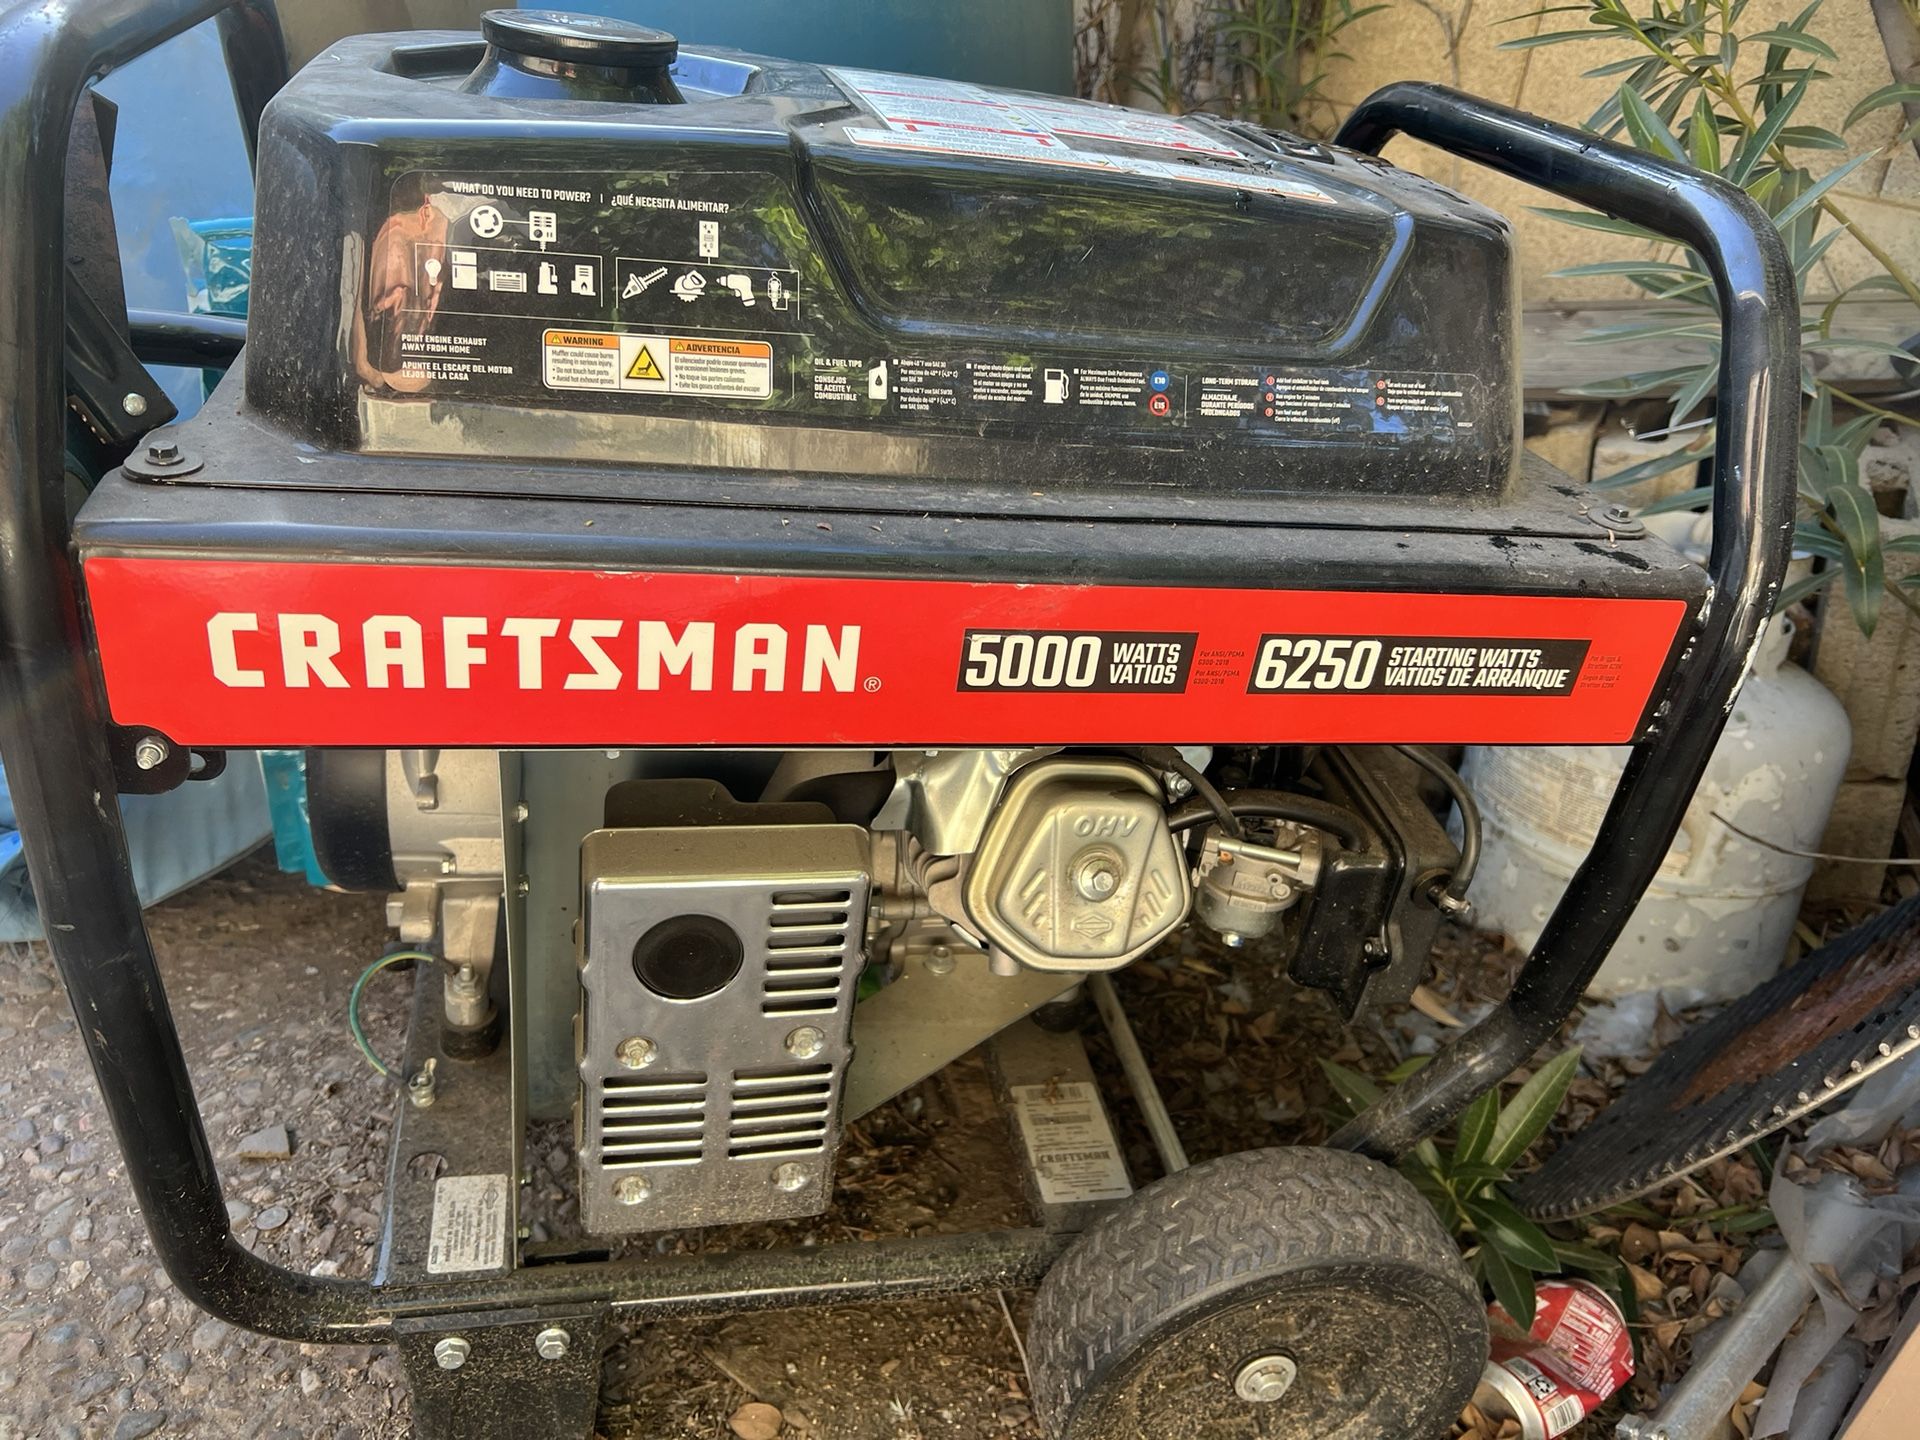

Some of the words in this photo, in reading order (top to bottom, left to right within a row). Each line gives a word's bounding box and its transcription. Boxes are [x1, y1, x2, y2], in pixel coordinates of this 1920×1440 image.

[452, 182, 480, 193] WHAT
[482, 184, 494, 195] DO
[496, 186, 514, 196] YOU
[516, 187, 539, 198] NEED
[541, 189, 552, 199] TO
[554, 190, 591, 202] POWER?
[611, 194, 633, 206] ¿QUÉ
[636, 196, 675, 209] NECESITA
[677, 199, 729, 213] ALIMENTAR?
[402, 334, 423, 342] POINT
[425, 335, 452, 344] ENGINE
[454, 337, 487, 346] EXHAUST
[564, 336, 603, 346] WARNING
[402, 343, 424, 351] AWAY
[427, 344, 447, 352] FROM
[686, 344, 740, 353] ADVERTENCIA
[402, 362, 431, 370] APUNTE
[443, 363, 471, 372] ESCAPE
[473, 365, 486, 373] DEL
[488, 365, 513, 374] MOTOR
[832, 359, 847, 367] FUEL
[427, 371, 436, 379] DE
[438, 372, 447, 380] LA
[449, 373, 468, 381] CASA
[815, 376, 846, 384] CONSEJOS
[1202, 377, 1233, 385] LONG-TERM
[815, 392, 857, 401] COMBUSTIBLE
[1154, 401, 1165, 409] E15
[206, 612, 861, 692] CRAFTSMAN
[1113, 642, 1181, 664] WATTS
[1388, 646, 1474, 668] STARTING
[1477, 648, 1541, 668] WATTS
[965, 634, 1102, 687] 5000
[1255, 638, 1383, 690] 6250
[1109, 664, 1178, 684] VATIOS
[1384, 667, 1443, 687] VATIOS
[1448, 668, 1471, 687] DE
[1475, 669, 1570, 690] ARRANQUE
[1074, 815, 1140, 838] OHV
[1040, 1151, 1111, 1163] CRAFTSMAN
